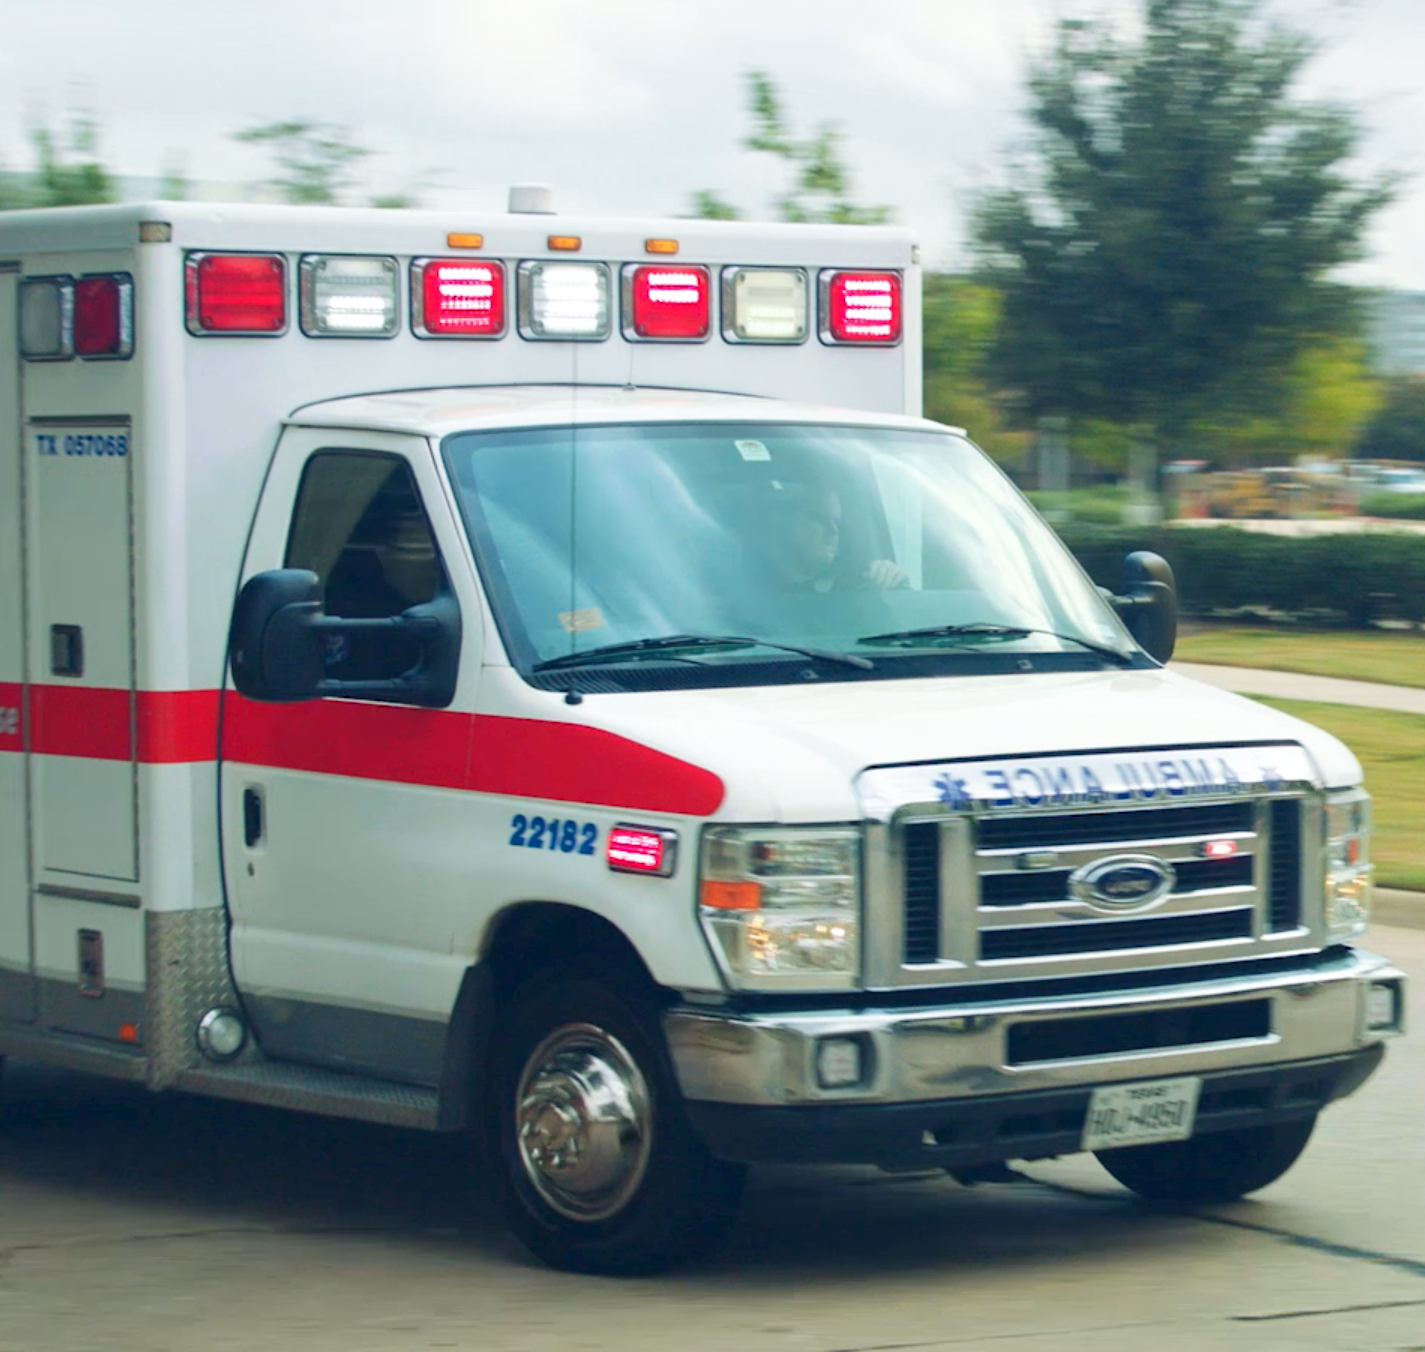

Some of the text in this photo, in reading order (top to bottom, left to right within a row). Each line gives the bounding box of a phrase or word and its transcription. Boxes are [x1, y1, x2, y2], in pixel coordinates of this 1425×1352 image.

[36, 434, 127, 456] TX 057068
[509, 814, 598, 855] 22182
